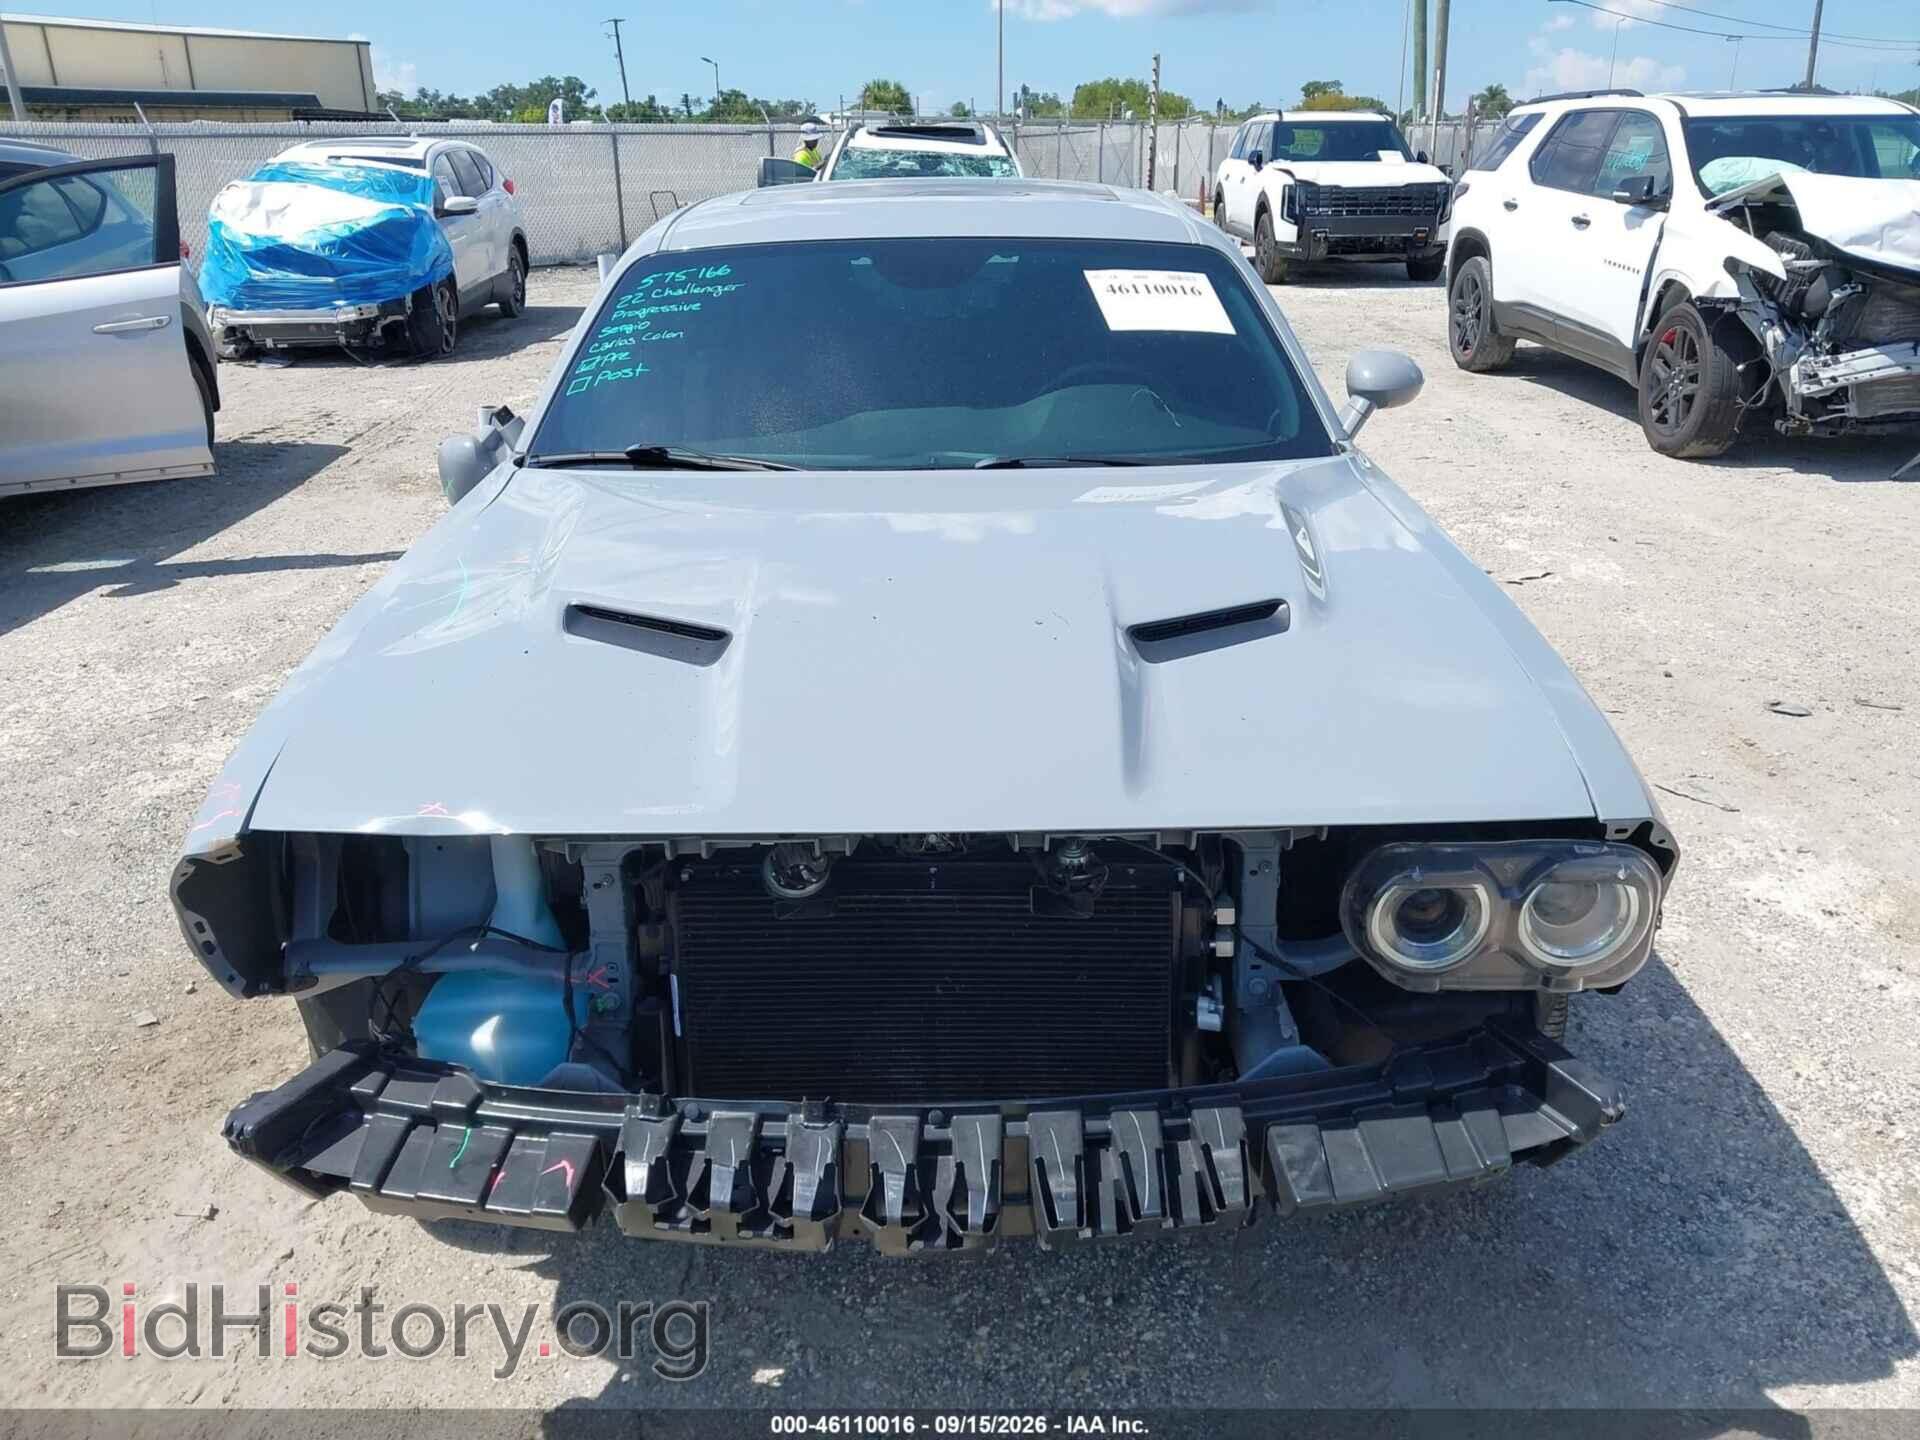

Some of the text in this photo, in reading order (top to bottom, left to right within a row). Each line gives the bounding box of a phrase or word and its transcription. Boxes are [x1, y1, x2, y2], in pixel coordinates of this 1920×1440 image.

[616, 282, 745, 309] 22 Challenger
[1106, 283, 1203, 296] 46110016
